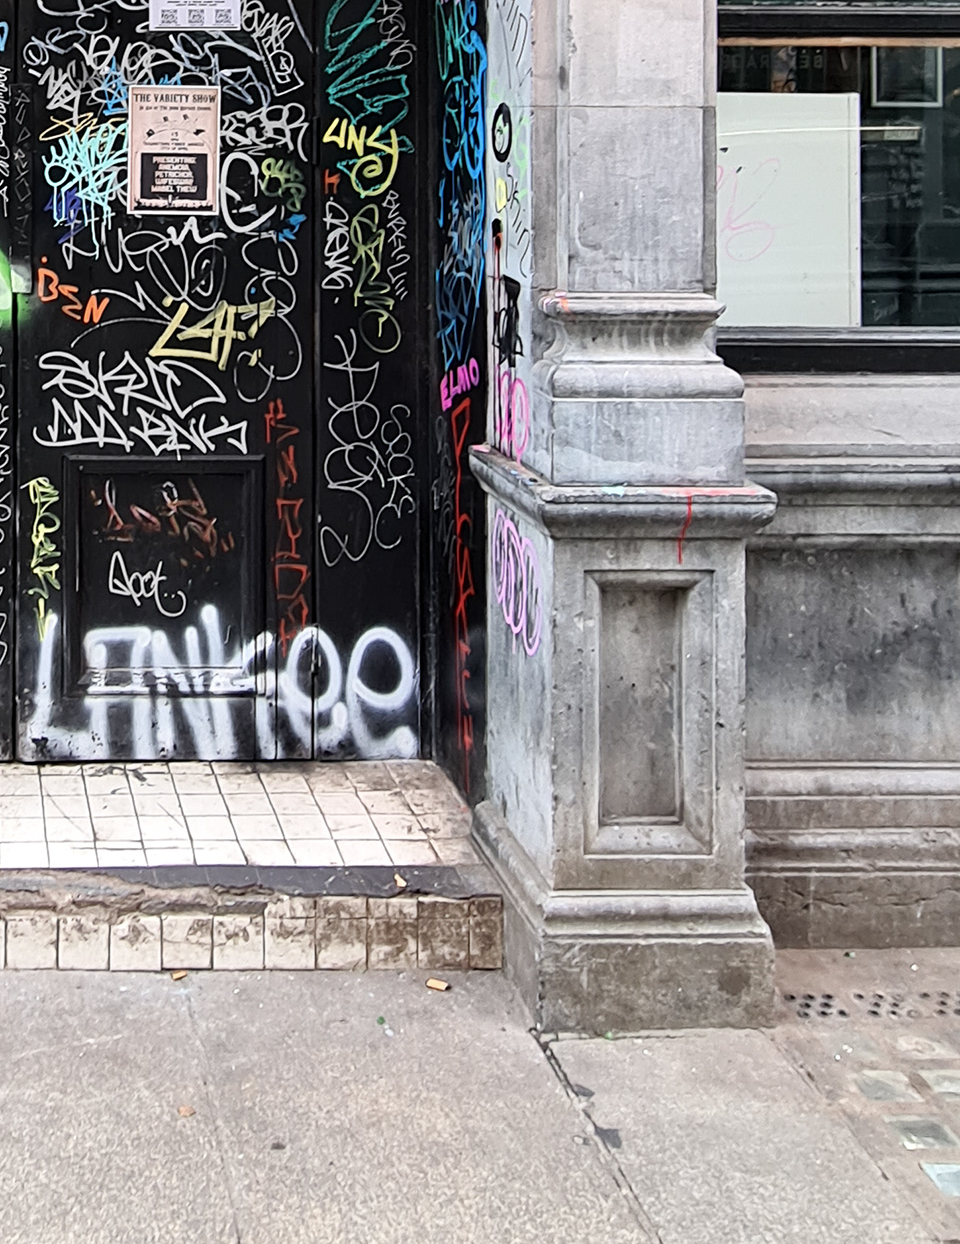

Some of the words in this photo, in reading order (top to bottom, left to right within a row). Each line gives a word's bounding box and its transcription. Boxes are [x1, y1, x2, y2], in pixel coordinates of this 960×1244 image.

[134, 93, 151, 103] THE
[153, 93, 190, 103] VARIETY
[192, 94, 217, 104] SHOW
[38, 267, 109, 324] BEN
